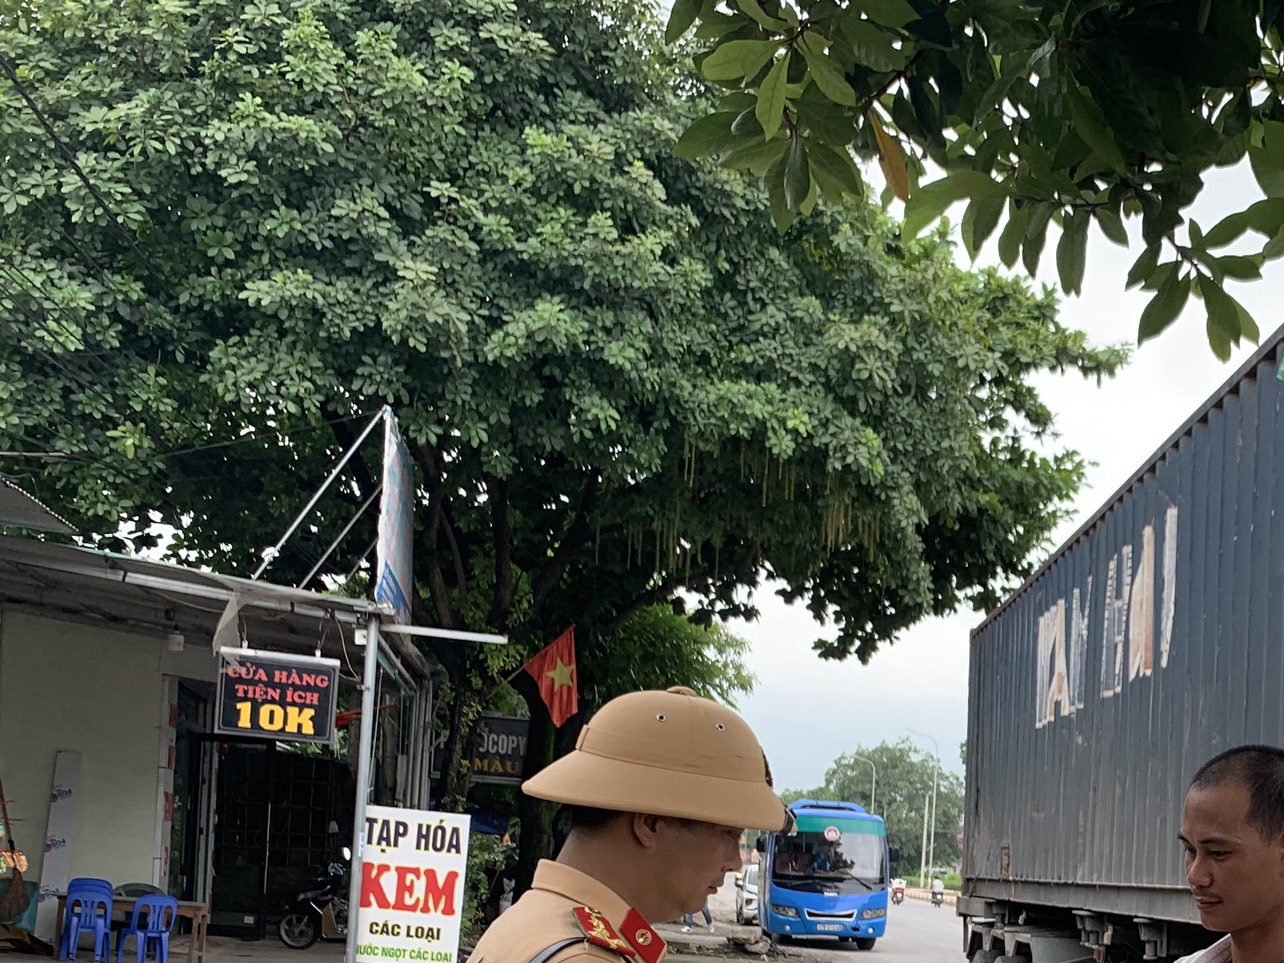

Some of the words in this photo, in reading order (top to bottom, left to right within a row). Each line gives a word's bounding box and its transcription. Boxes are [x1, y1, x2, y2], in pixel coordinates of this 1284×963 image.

[273, 668, 329, 688] HÀNG
[235, 683, 280, 702] TIỆN
[286, 686, 320, 705] ÍCH
[236, 701, 315, 735] 10K
[365, 817, 409, 853] TẠP
[416, 819, 461, 855] HÓA
[359, 861, 459, 916] KEM
[369, 920, 401, 937] CÁC
[406, 925, 441, 943] LOẠI
[409, 947, 429, 961] CÁC
